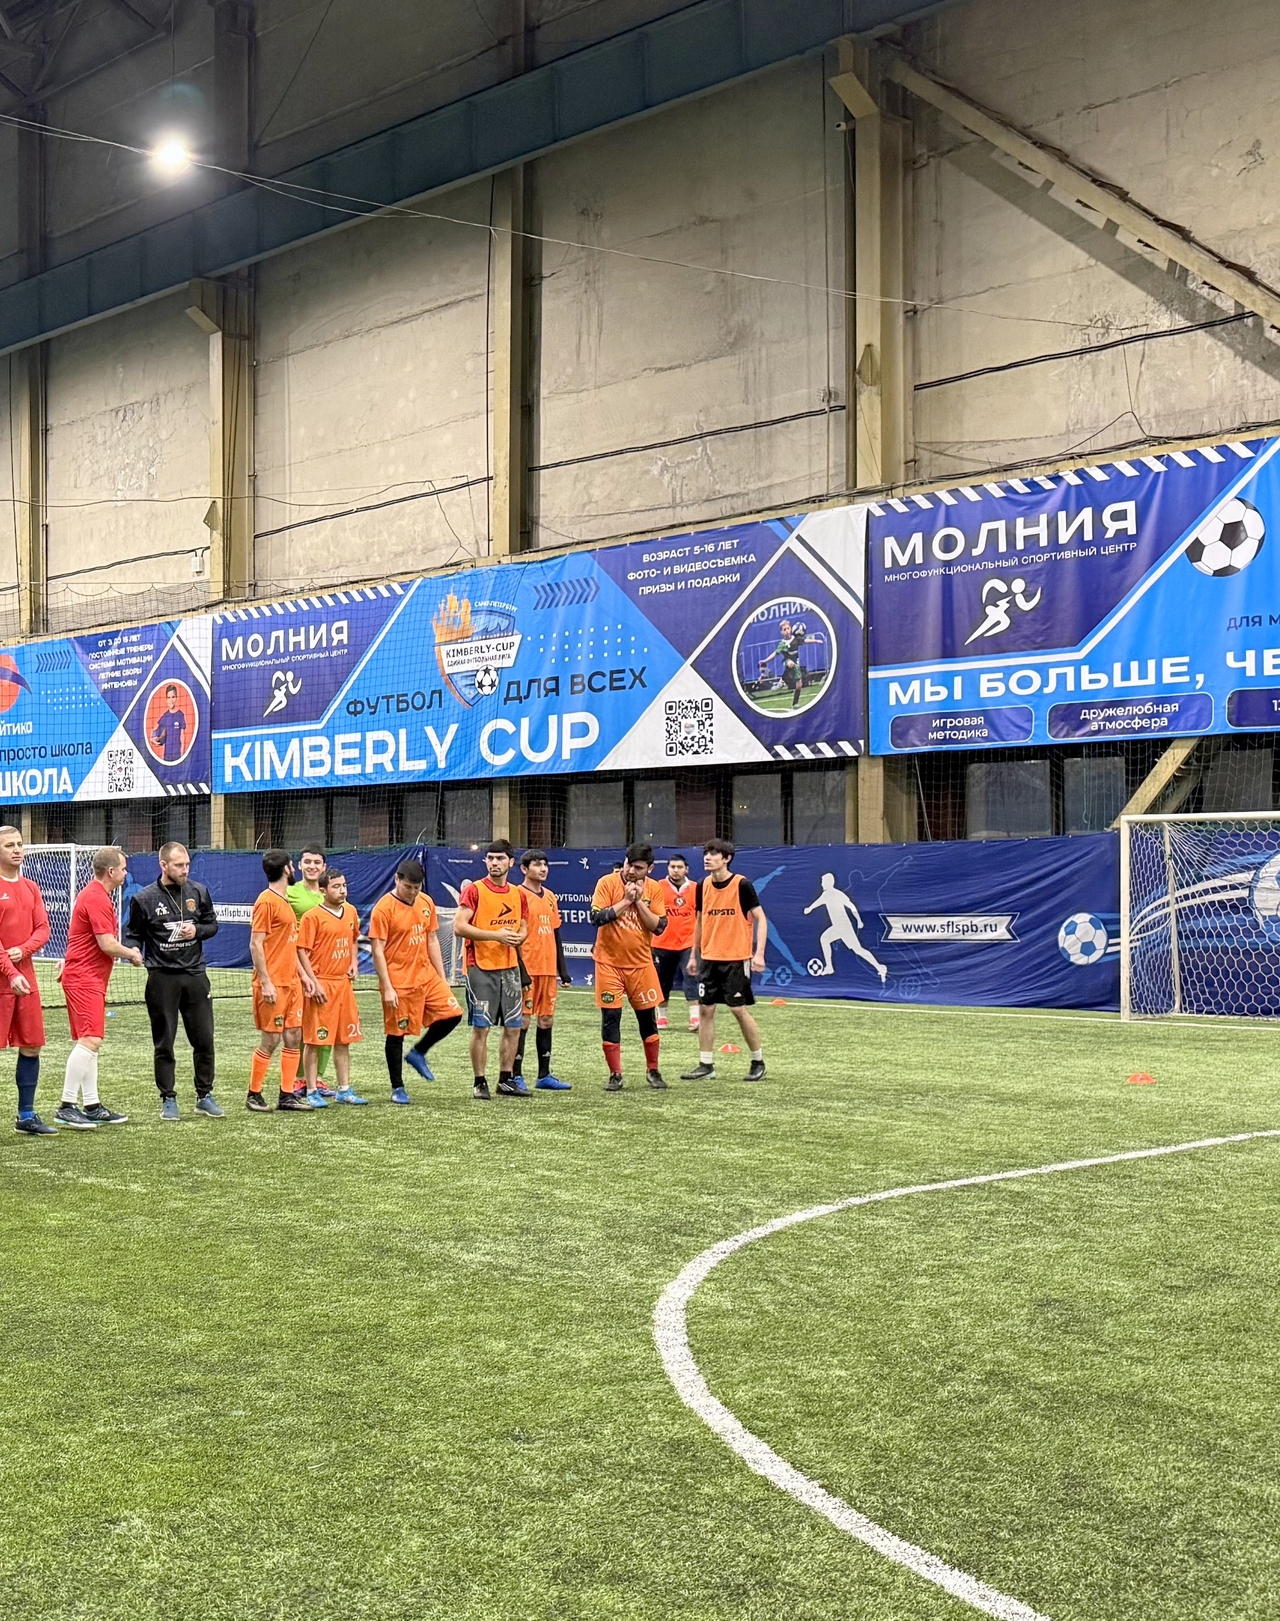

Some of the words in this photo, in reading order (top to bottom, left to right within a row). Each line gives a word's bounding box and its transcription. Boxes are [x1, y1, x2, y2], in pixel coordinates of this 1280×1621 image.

[884, 500, 1137, 568] МОЛНИЯ
[642, 547, 691, 563] ВОЗРАСТ
[693, 543, 715, 555] 5-16
[717, 539, 740, 551] ЛЕТ
[884, 556, 1019, 582] МНОГОФУНКЦИОНАЛЬНЫЙ
[1021, 546, 1097, 564] СПОРТИВНЫЙ
[1100, 542, 1138, 555] ЦЕНТР
[627, 568, 661, 581] ФОТО-
[663, 566, 672, 575] И
[638, 583, 675, 596] ПРИЗЫ
[677, 581, 686, 590] И
[687, 573, 741, 590] ПОДАРКИ
[222, 619, 348, 662] МОЛНИЯ
[445, 641, 515, 659] KIMBERLY-CUP
[888, 675, 962, 706] МЫ
[980, 656, 1205, 698] БОЛЬШЕ,
[345, 689, 443, 718] ФУТБОЛ
[503, 676, 560, 706] ДЛЯ
[570, 666, 647, 695] ВСЕХ
[1079, 702, 1180, 721] дружелюбная
[931, 716, 985, 729] игровая
[1090, 716, 1169, 732] атмосфера
[928, 727, 989, 741] методика
[50, 741, 93, 756] школа
[224, 724, 460, 783] KIMBERLY
[479, 712, 600, 767] CUP
[901, 921, 998, 936] www.sflspb.ru
[335, 937, 349, 948] TIK
[638, 987, 658, 1005] 10
[698, 982, 706, 997] 6
